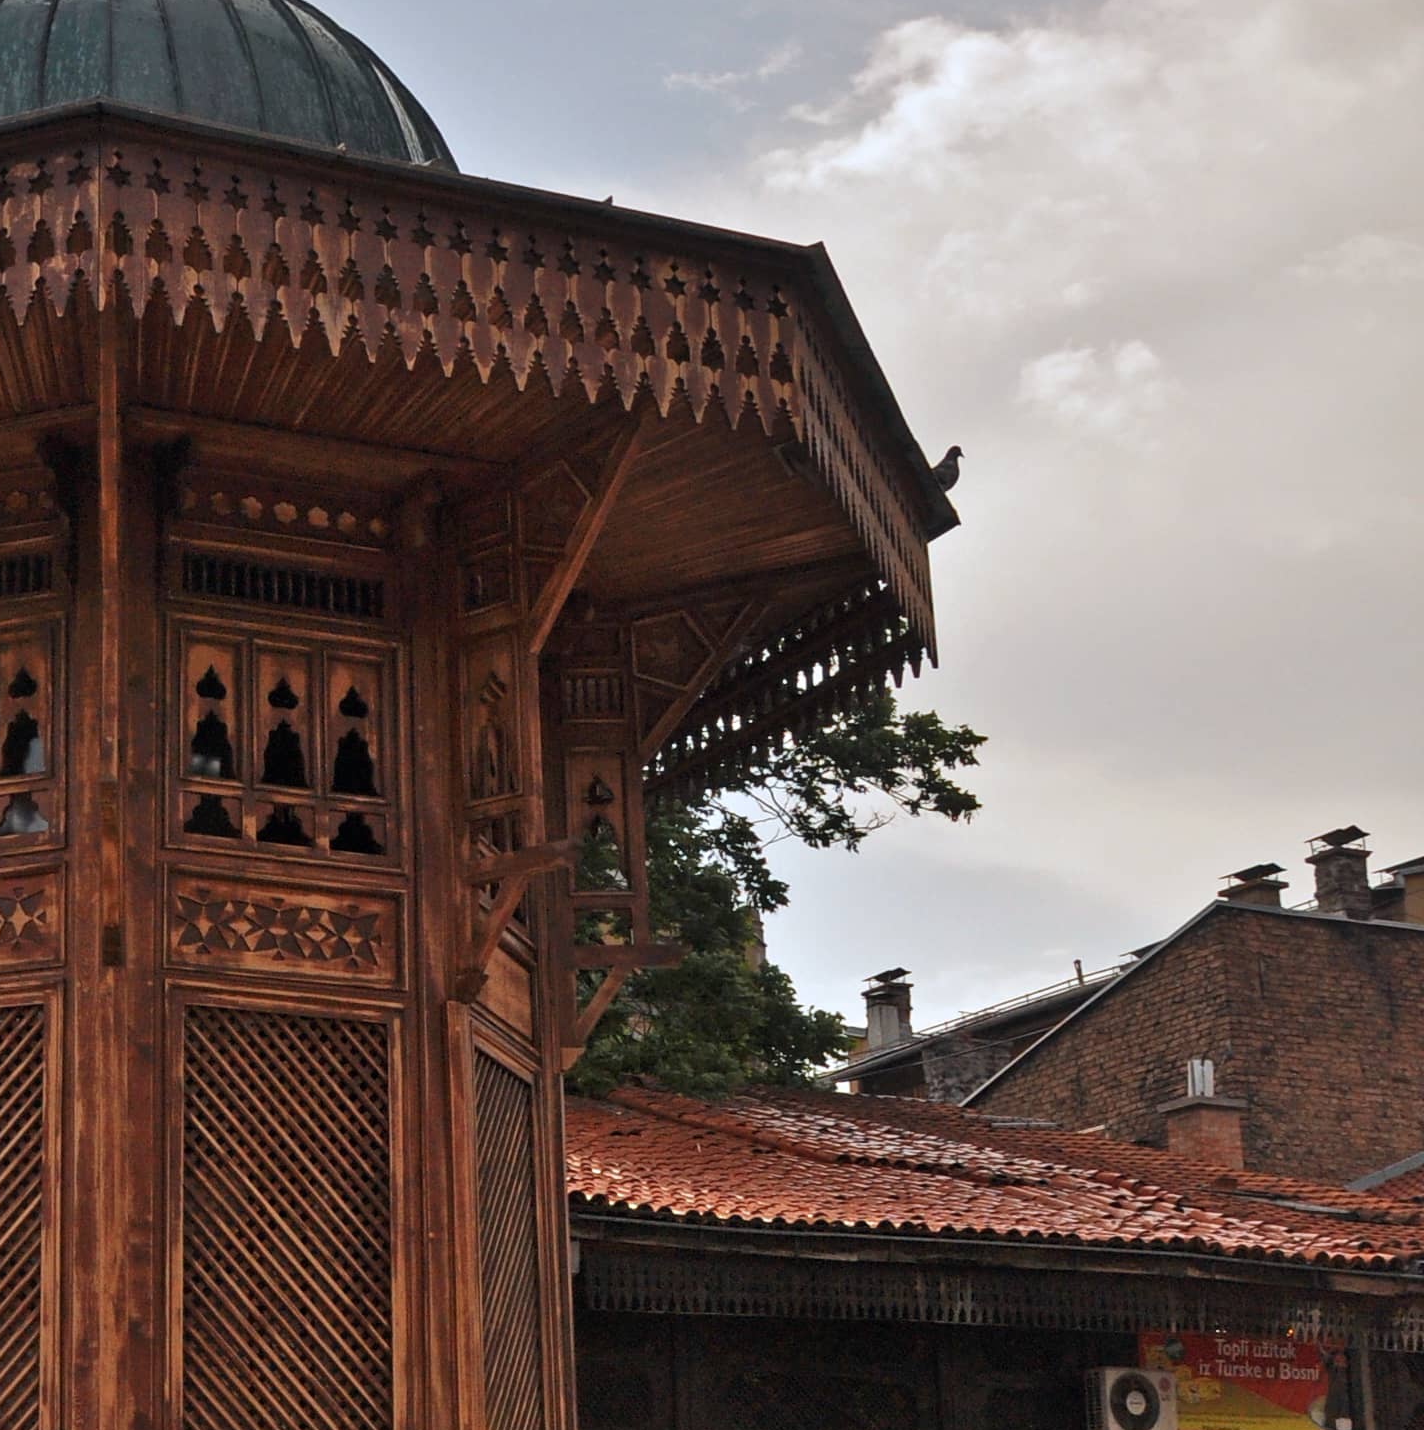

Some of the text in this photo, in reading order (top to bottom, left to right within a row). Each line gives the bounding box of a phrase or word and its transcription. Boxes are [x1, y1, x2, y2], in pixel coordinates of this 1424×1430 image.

[1214, 1338, 1249, 1361] Topli
[1215, 1359, 1262, 1378] Turske
[1266, 1366, 1275, 1379] u
[1279, 1362, 1320, 1381] Bosni
